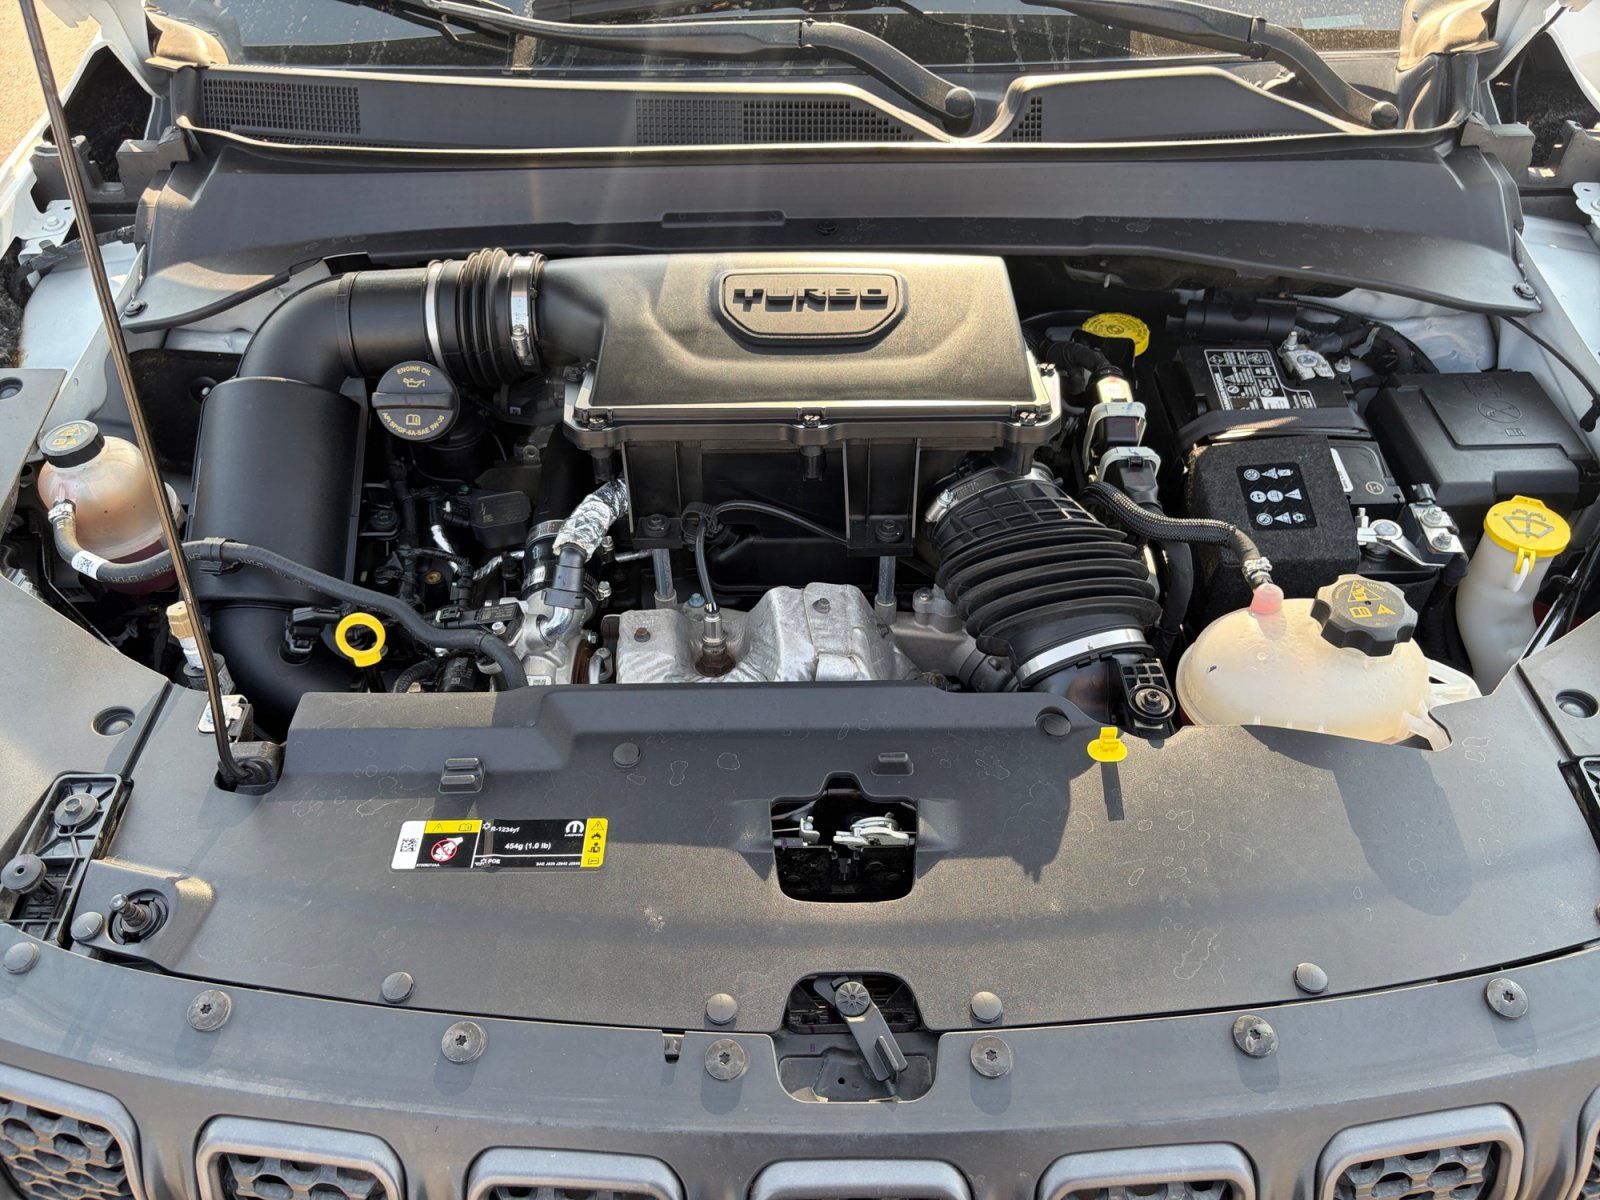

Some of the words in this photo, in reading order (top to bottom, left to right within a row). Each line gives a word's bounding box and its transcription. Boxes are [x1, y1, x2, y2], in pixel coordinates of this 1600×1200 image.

[733, 288, 889, 309] TURBO
[396, 365, 420, 375] ENGINE
[421, 367, 432, 376] OIL
[382, 412, 392, 424] API
[490, 826, 520, 834] R-1234yf
[504, 843, 523, 851] 454g
[525, 842, 539, 850] (1.0
